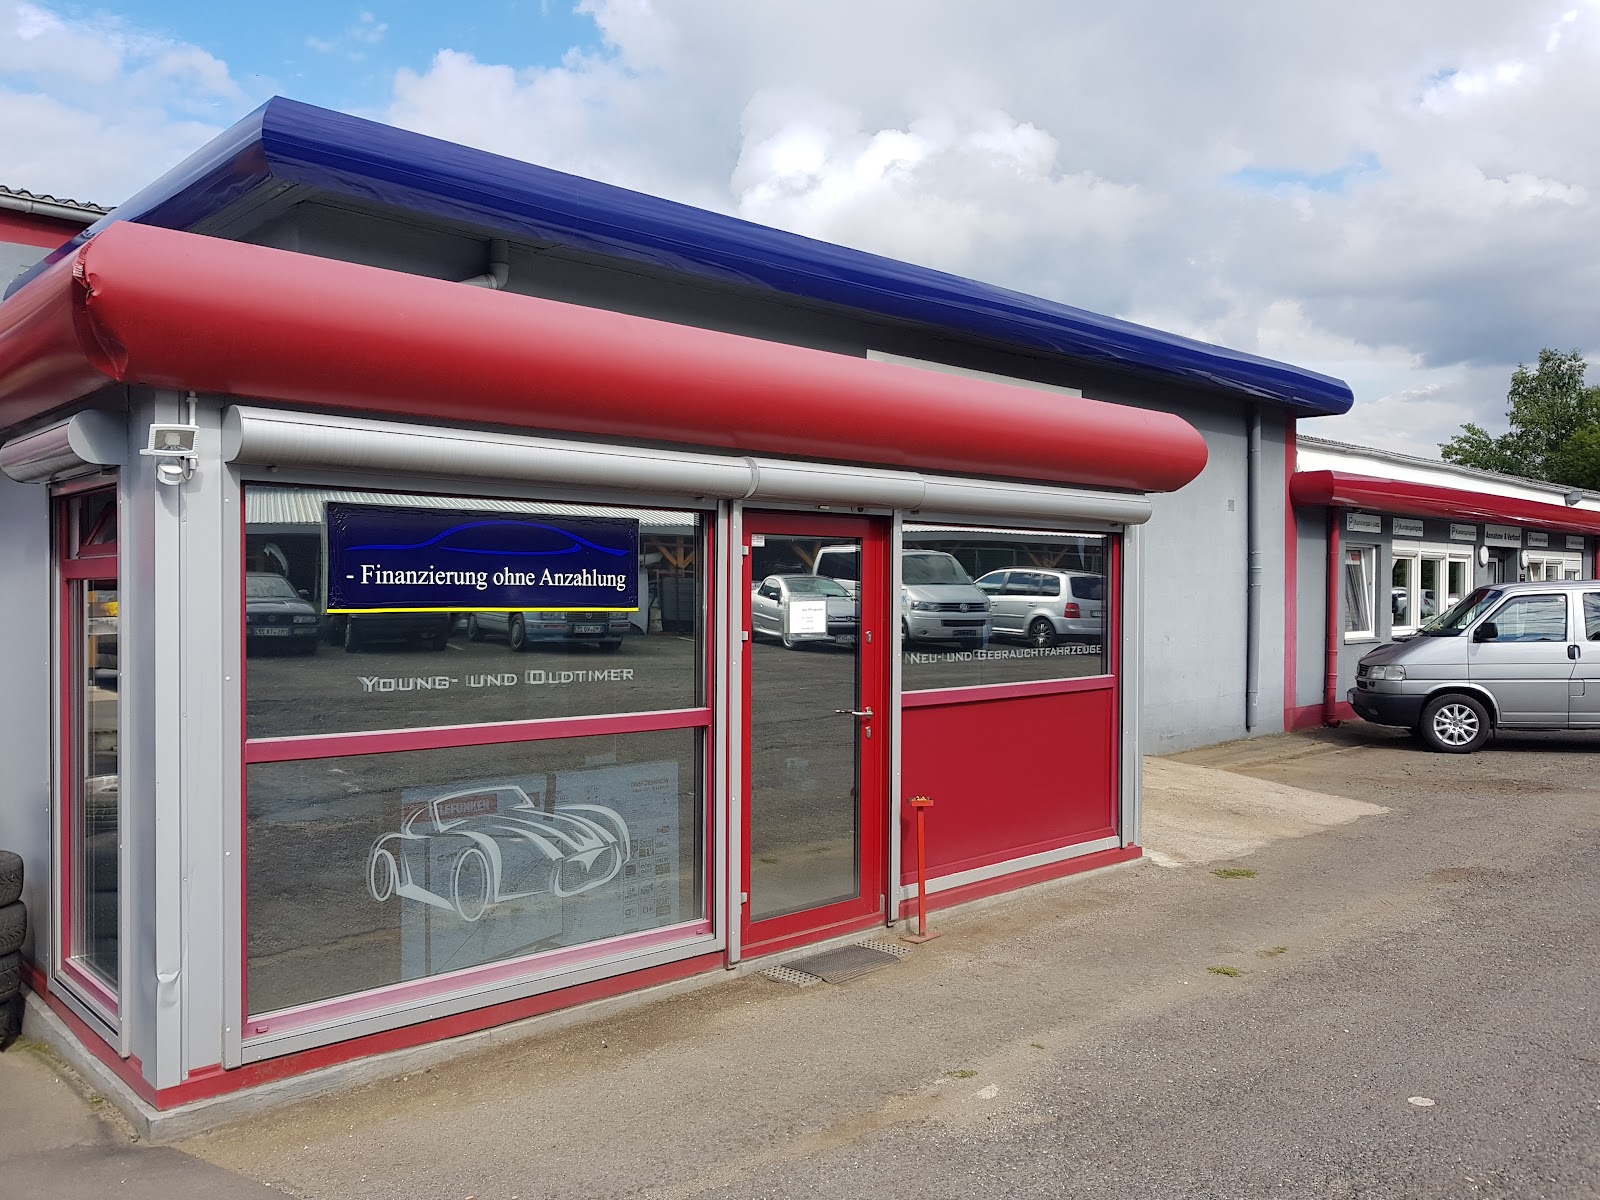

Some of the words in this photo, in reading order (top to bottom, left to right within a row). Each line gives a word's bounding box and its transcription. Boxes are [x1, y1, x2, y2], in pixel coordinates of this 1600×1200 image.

[360, 564, 487, 590] Finanzierung
[493, 567, 535, 586] ohne
[539, 568, 626, 591] Anzahlung
